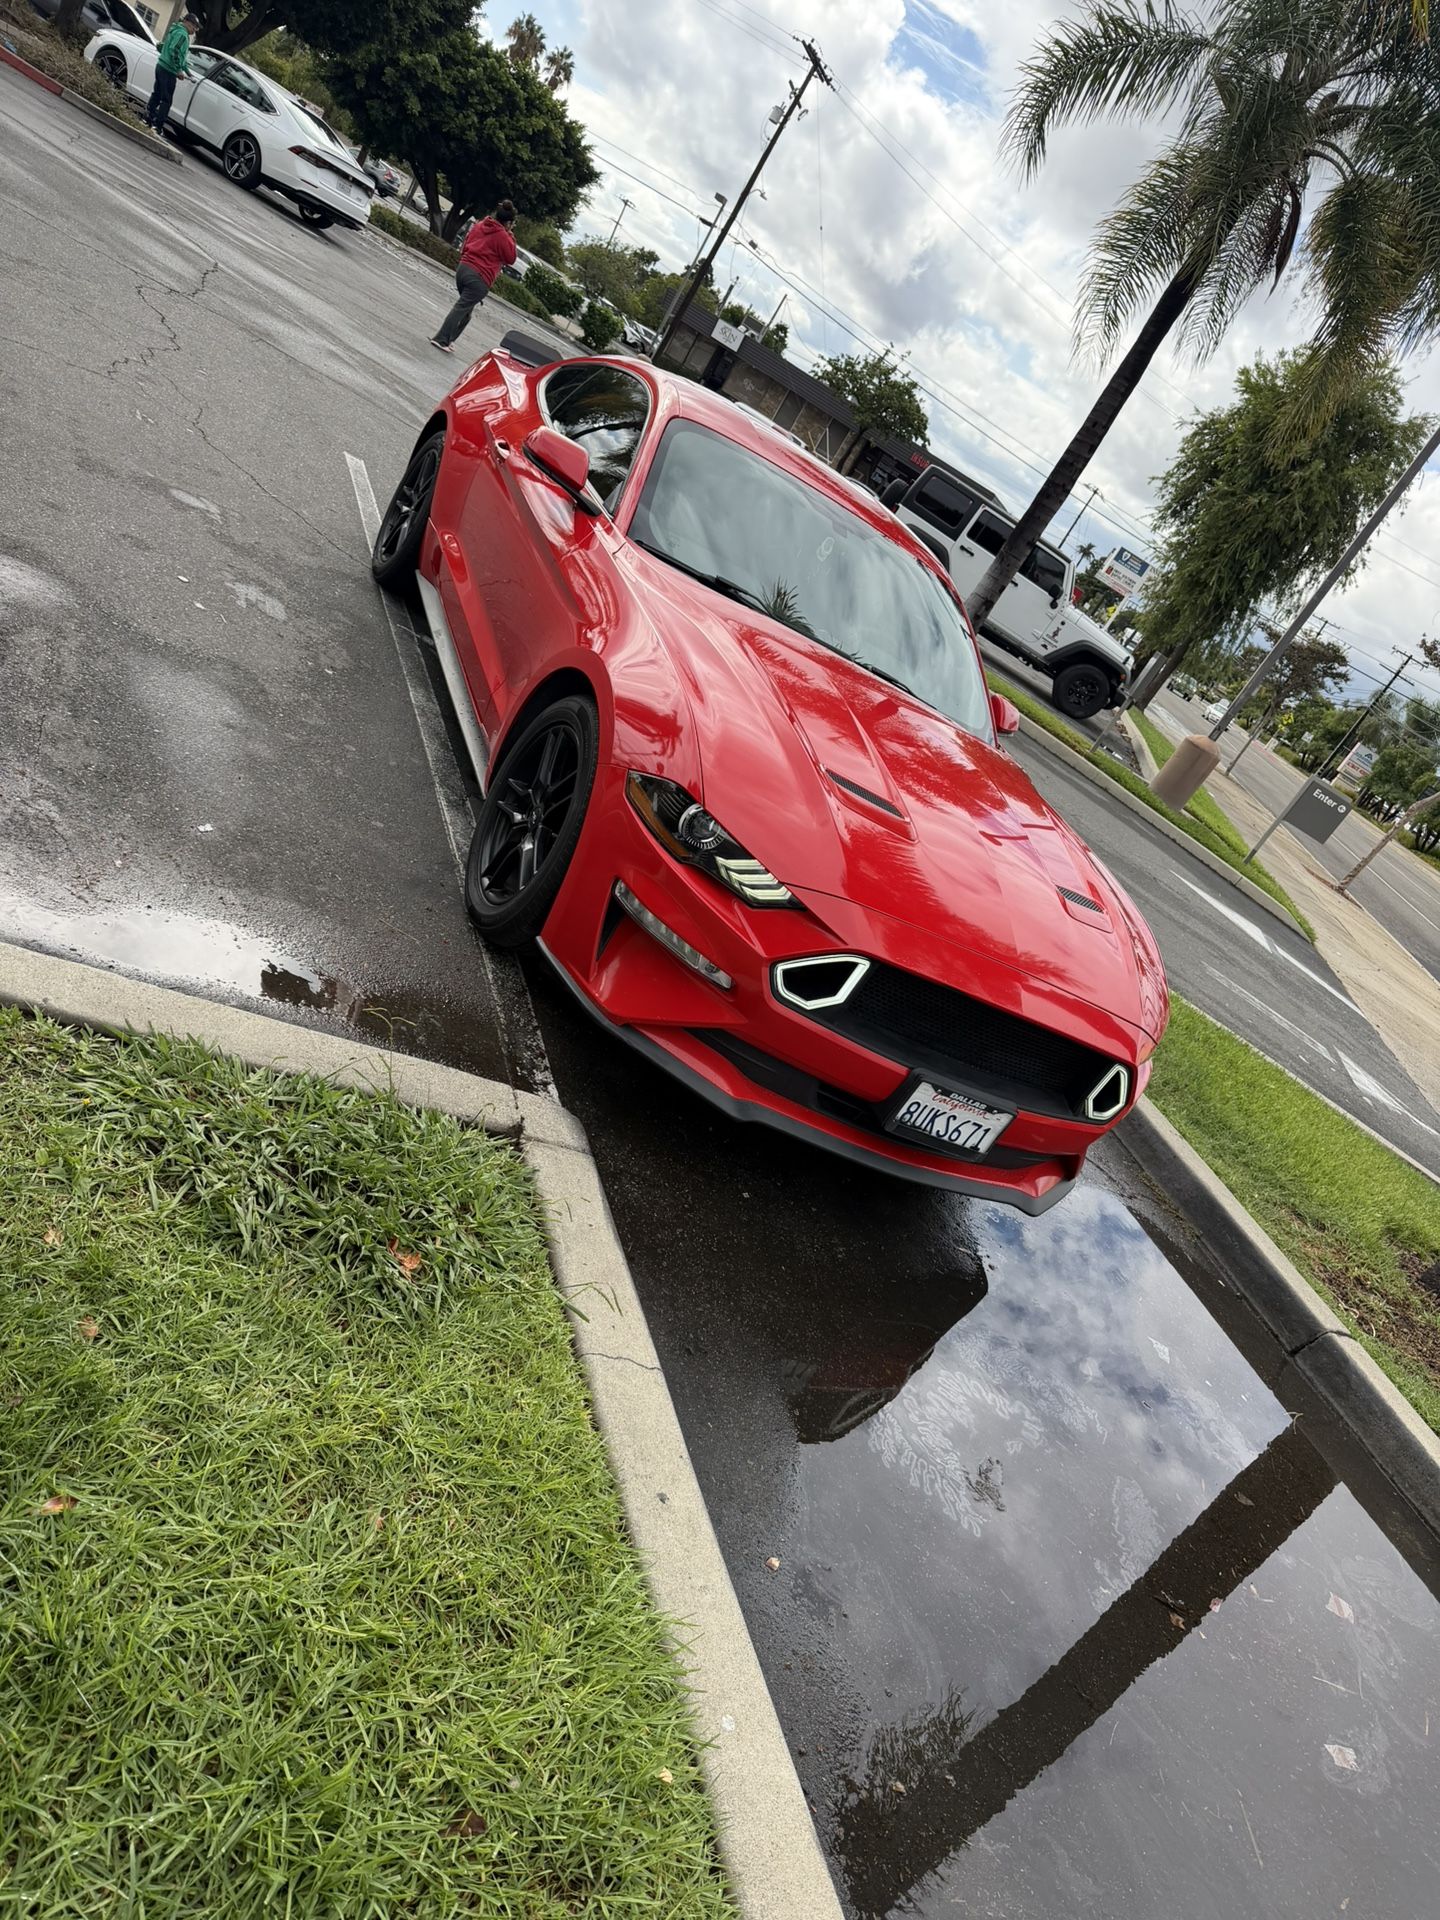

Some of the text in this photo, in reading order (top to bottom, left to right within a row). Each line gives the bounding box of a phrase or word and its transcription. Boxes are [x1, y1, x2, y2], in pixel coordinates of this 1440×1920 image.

[720, 327, 738, 342] SKIN
[1313, 788, 1337, 808] Enter
[932, 1092, 990, 1120] California
[949, 1092, 987, 1110] DALLAS
[900, 1101, 991, 1152] 8UKS671
